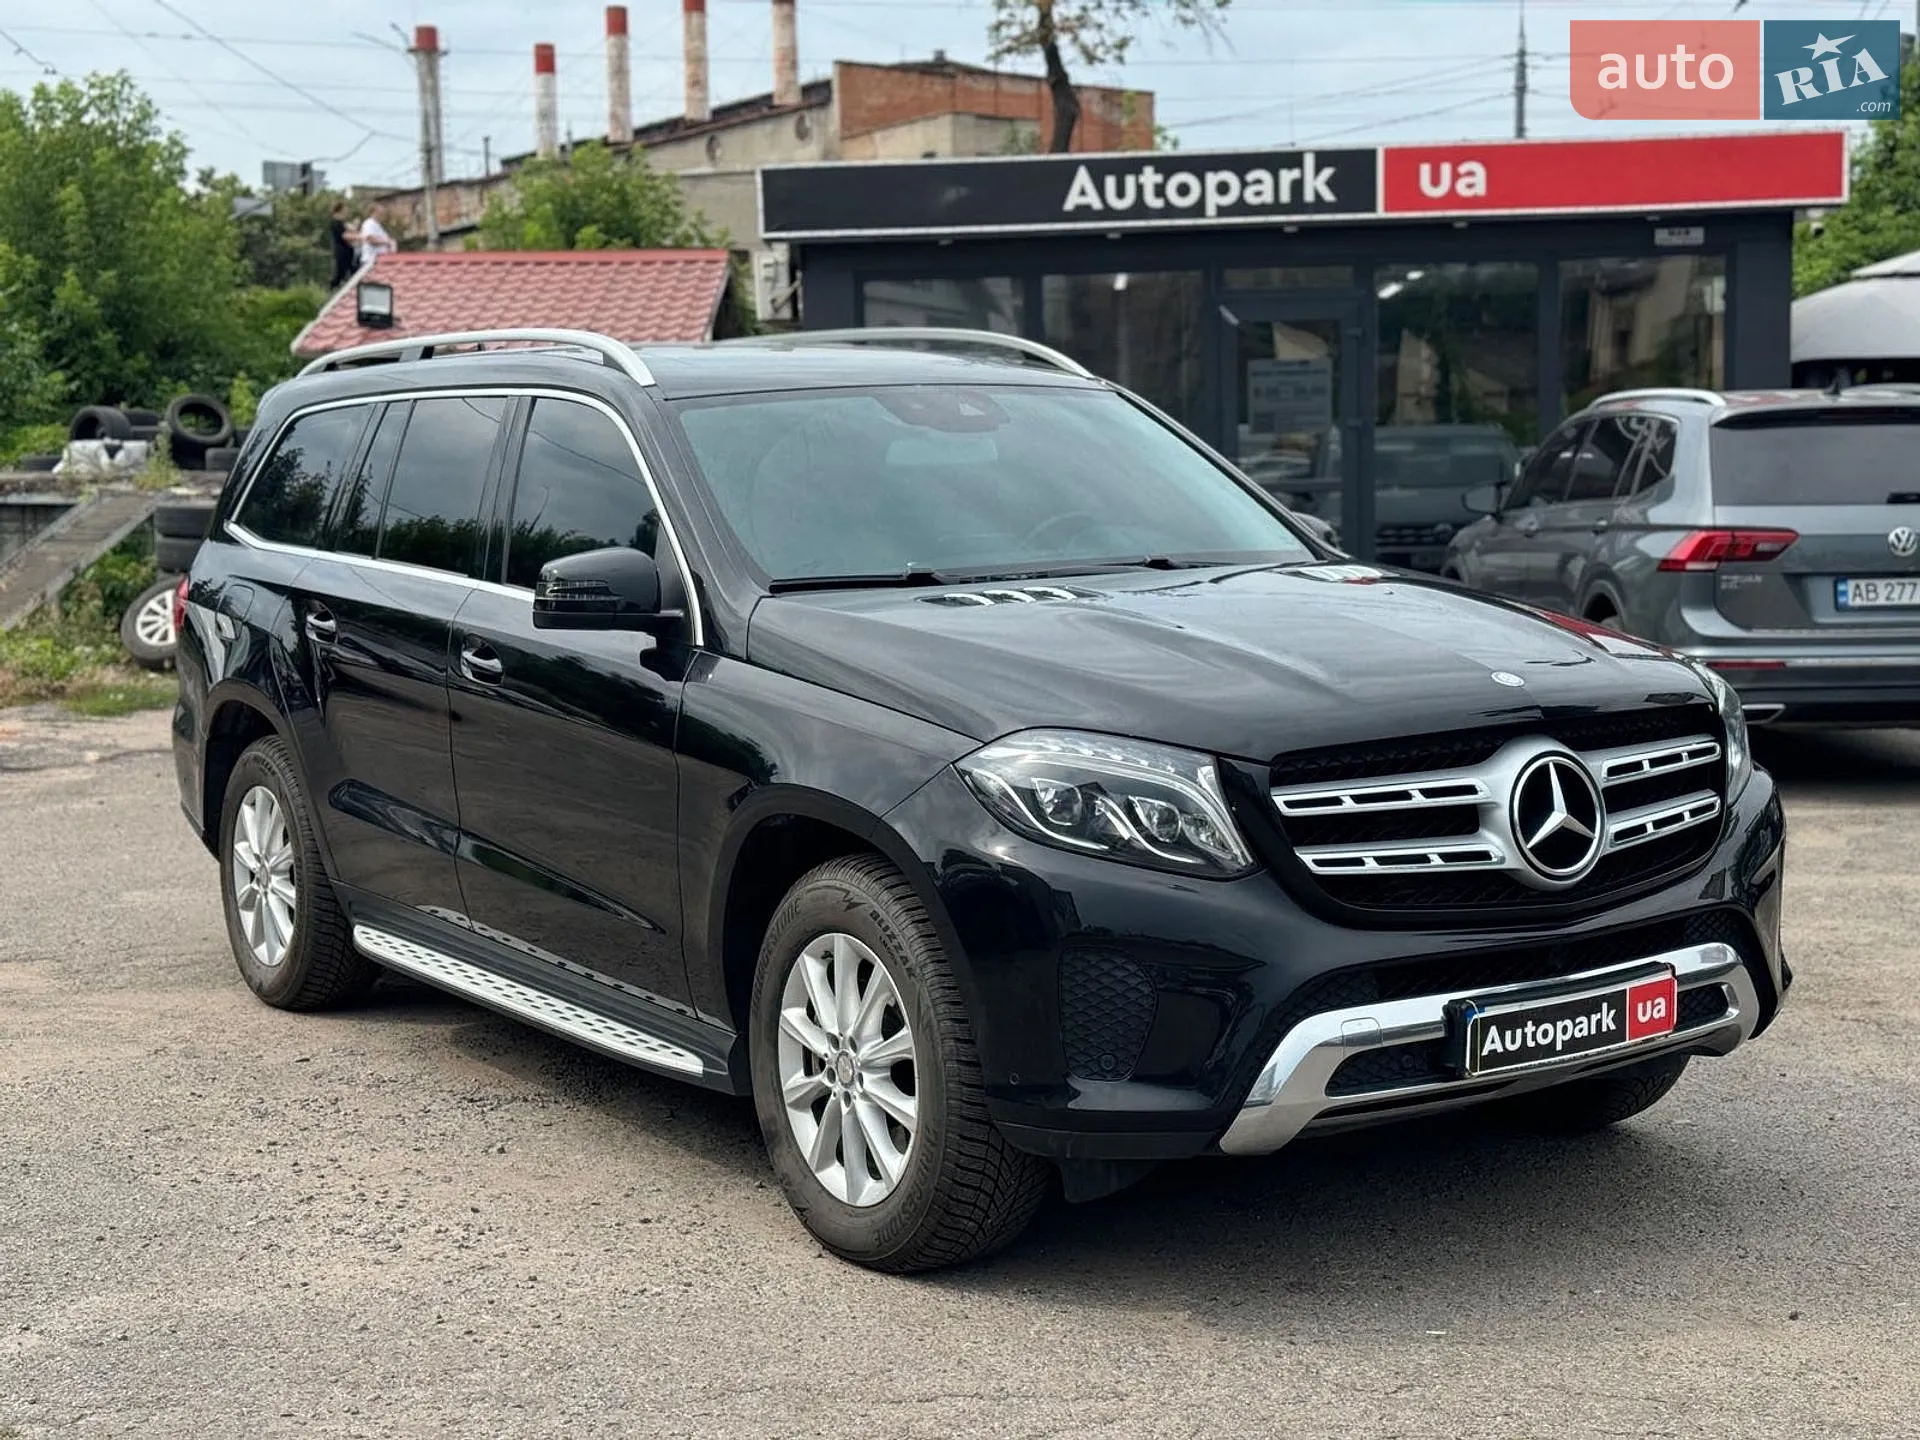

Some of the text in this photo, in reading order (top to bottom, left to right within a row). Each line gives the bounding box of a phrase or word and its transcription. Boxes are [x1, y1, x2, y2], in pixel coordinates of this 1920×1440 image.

[1062, 151, 1487, 217] Autopark ua
[1851, 583, 1880, 602] AB
[869, 909, 918, 981] BLIZZAK
[1481, 996, 1667, 1057] Autopark ua
